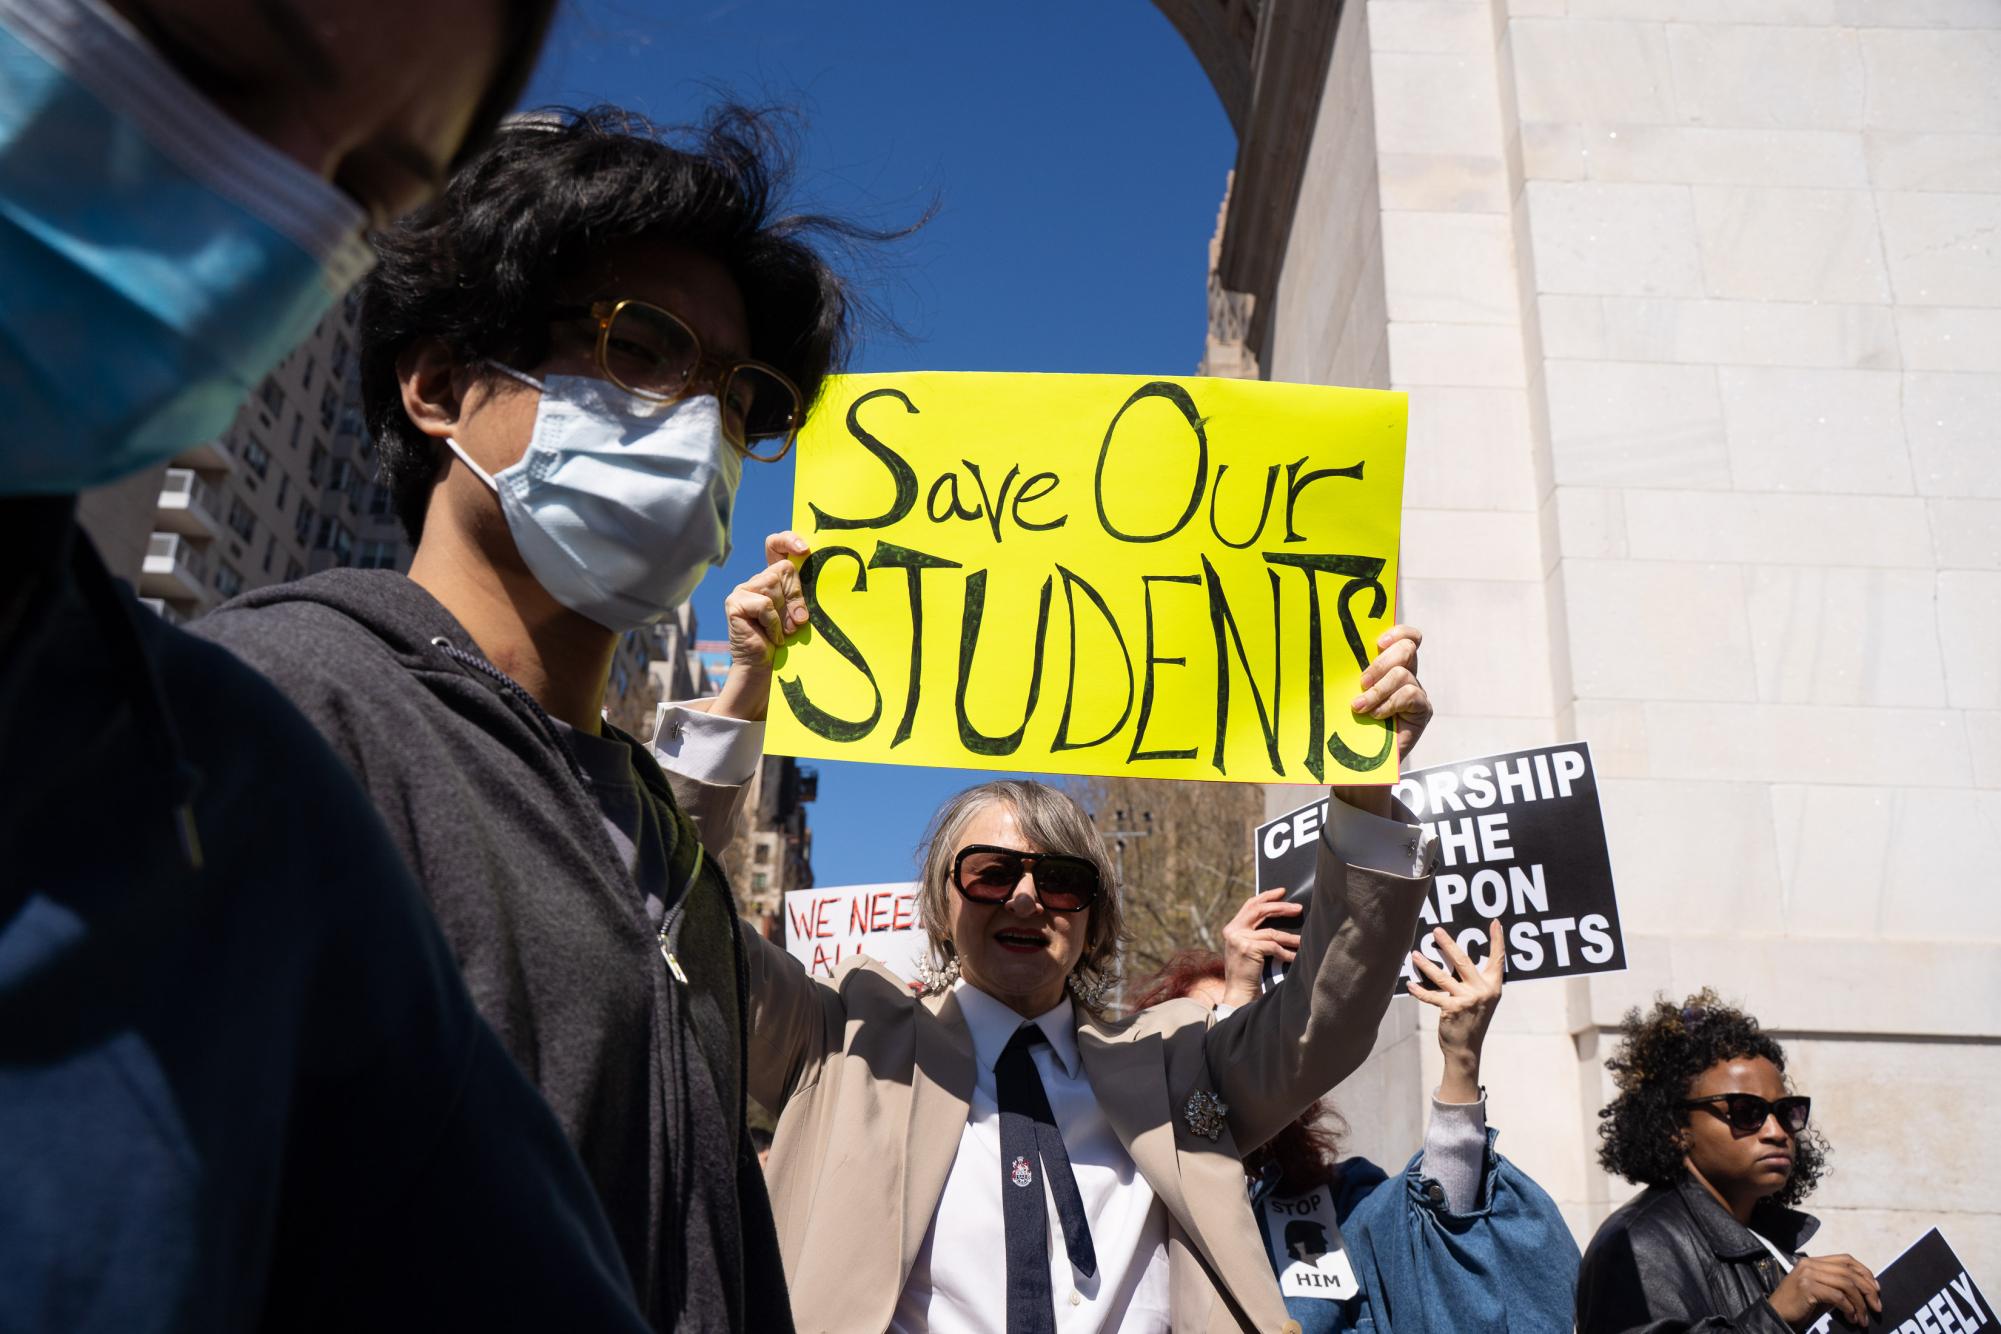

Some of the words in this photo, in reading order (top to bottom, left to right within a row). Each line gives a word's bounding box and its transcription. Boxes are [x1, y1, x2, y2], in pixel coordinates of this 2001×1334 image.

[807, 388, 1068, 543] Save
[1094, 381, 1365, 549] Our
[777, 540, 1393, 785] STUDENTS
[1264, 751, 1585, 860] CEORSHIP
[788, 897, 841, 940] WE
[849, 892, 914, 936] NEE
[1271, 1194, 1320, 1216] STOP
[1295, 1273, 1341, 1288] HIM
